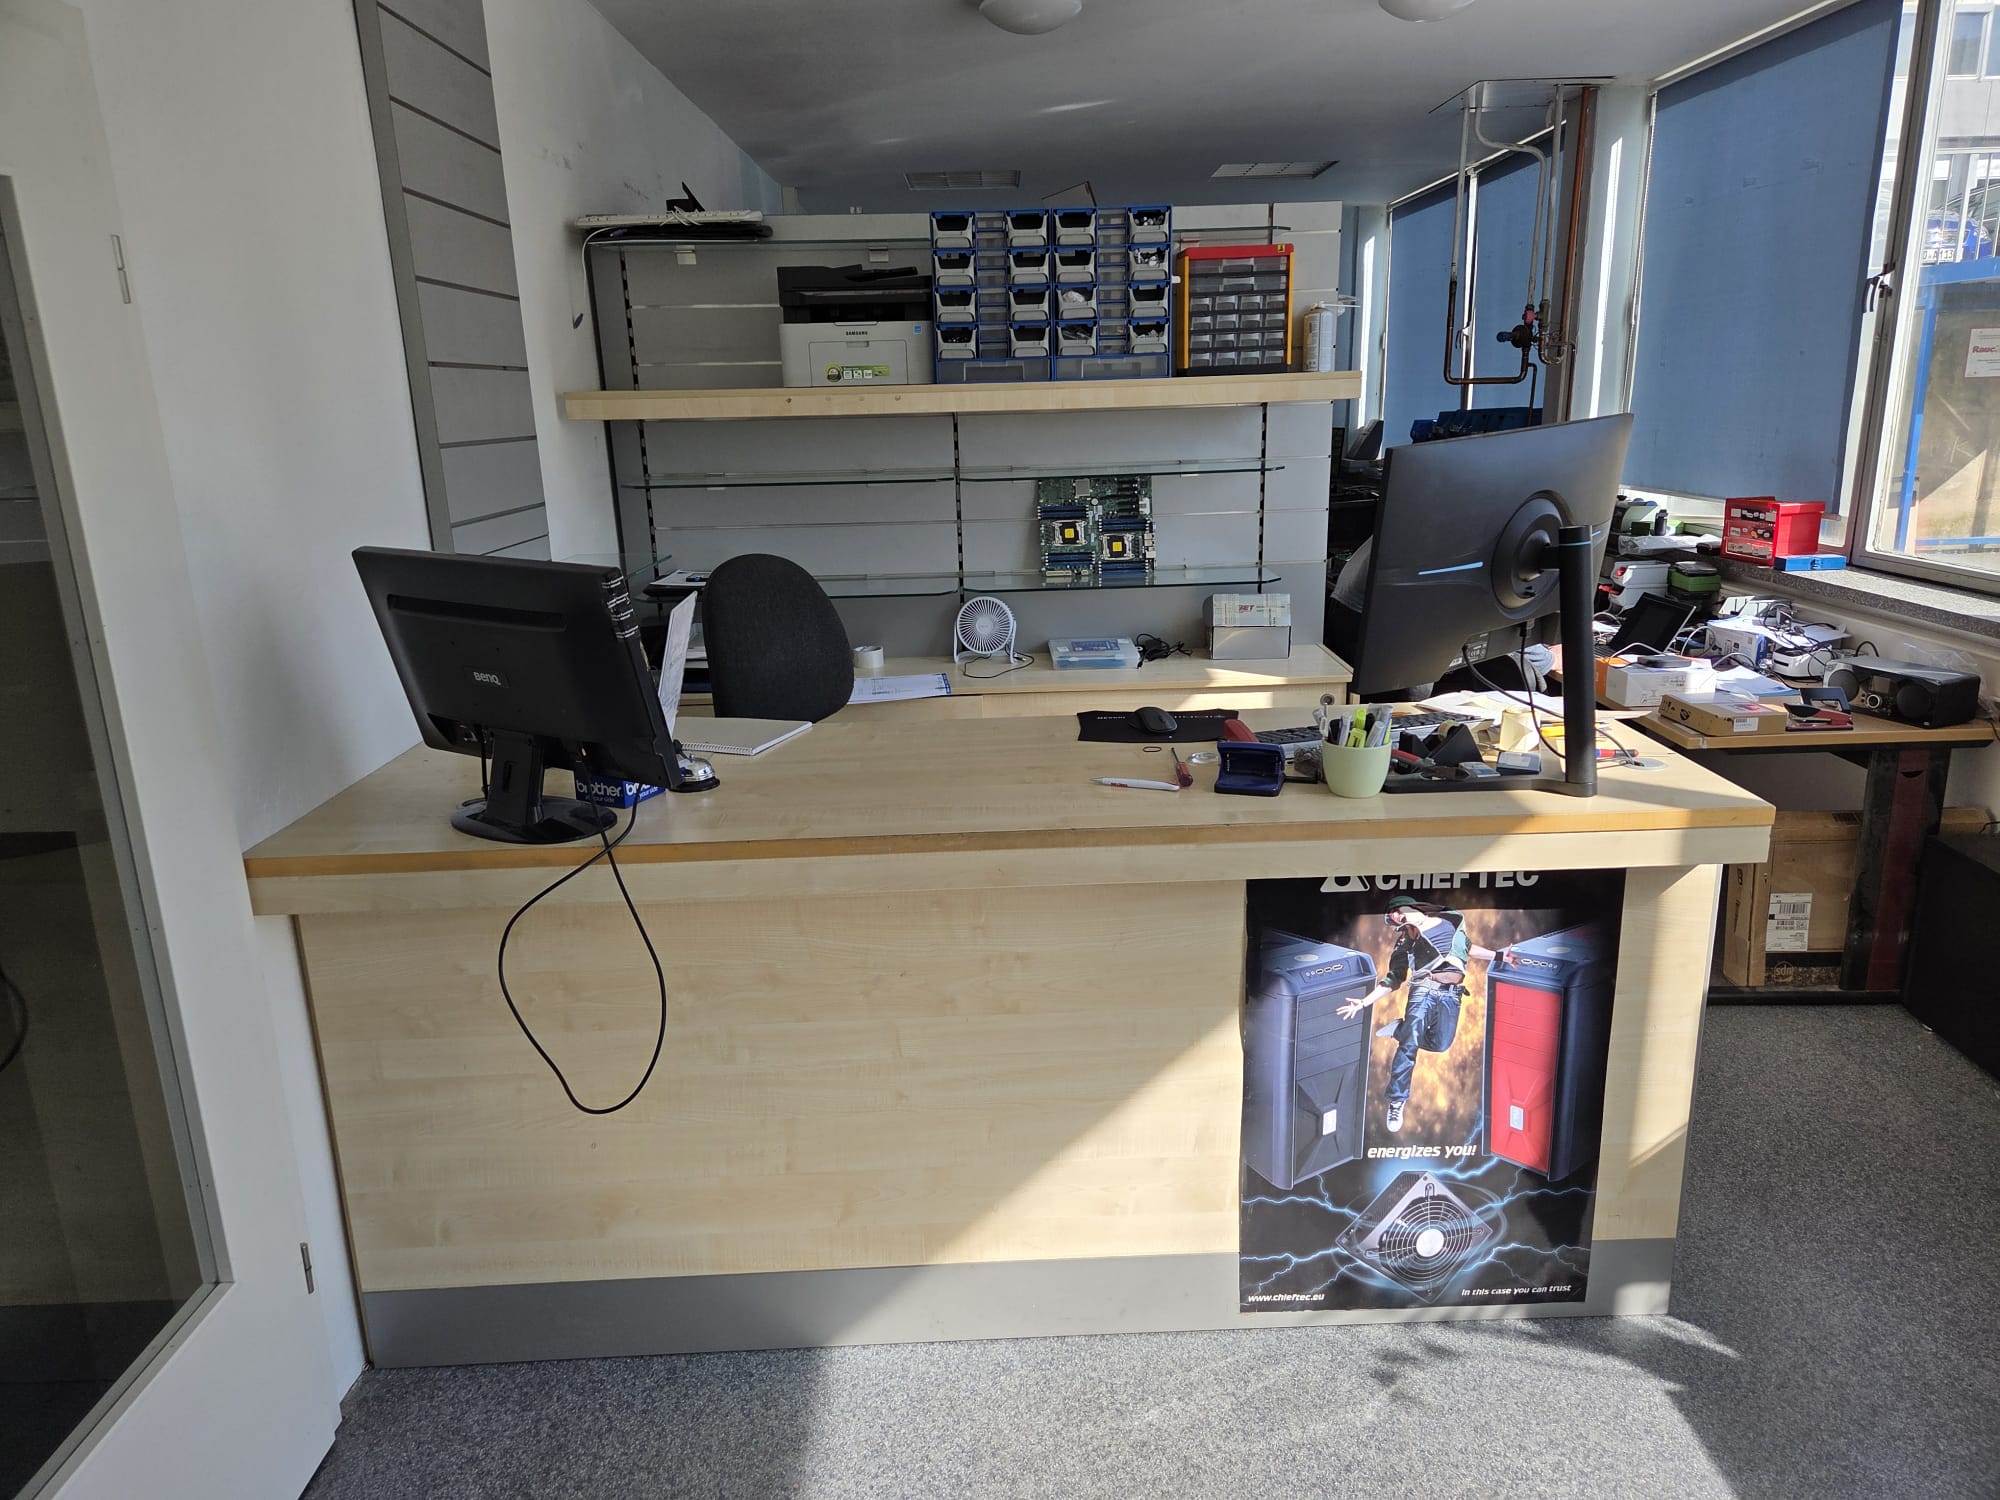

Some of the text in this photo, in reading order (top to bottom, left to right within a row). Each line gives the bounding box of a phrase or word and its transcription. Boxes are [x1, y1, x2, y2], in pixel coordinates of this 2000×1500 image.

[473, 671, 501, 686] BenQ
[1367, 1145, 1477, 1159] energizes you!
[1513, 1286, 1529, 1295] you
[1548, 1284, 1572, 1292] trust
[1248, 1293, 1325, 1302] www.chieftec.eu
